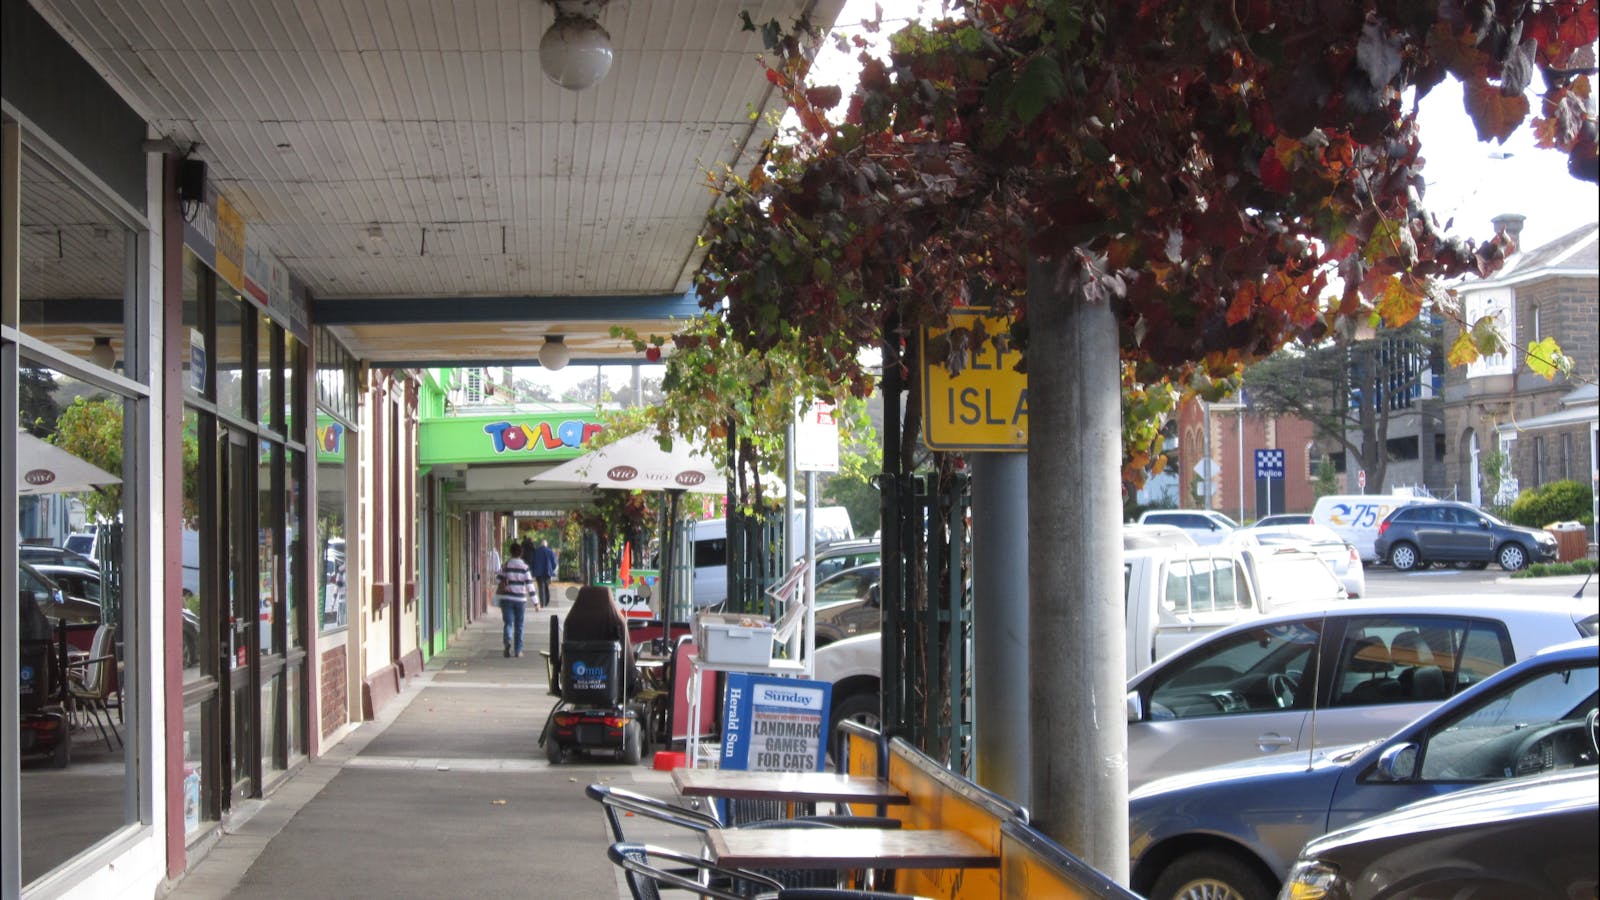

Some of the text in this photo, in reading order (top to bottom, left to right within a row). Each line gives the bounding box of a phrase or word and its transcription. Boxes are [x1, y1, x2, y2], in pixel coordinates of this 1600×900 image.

[1258, 469, 1282, 477] Police
[764, 689, 812, 706] Sunday
[725, 688, 742, 758] Herald Sun
[754, 721, 820, 739] LANDMARK
[765, 738, 807, 754] GAMES
[757, 752, 814, 770] FOR CATS
